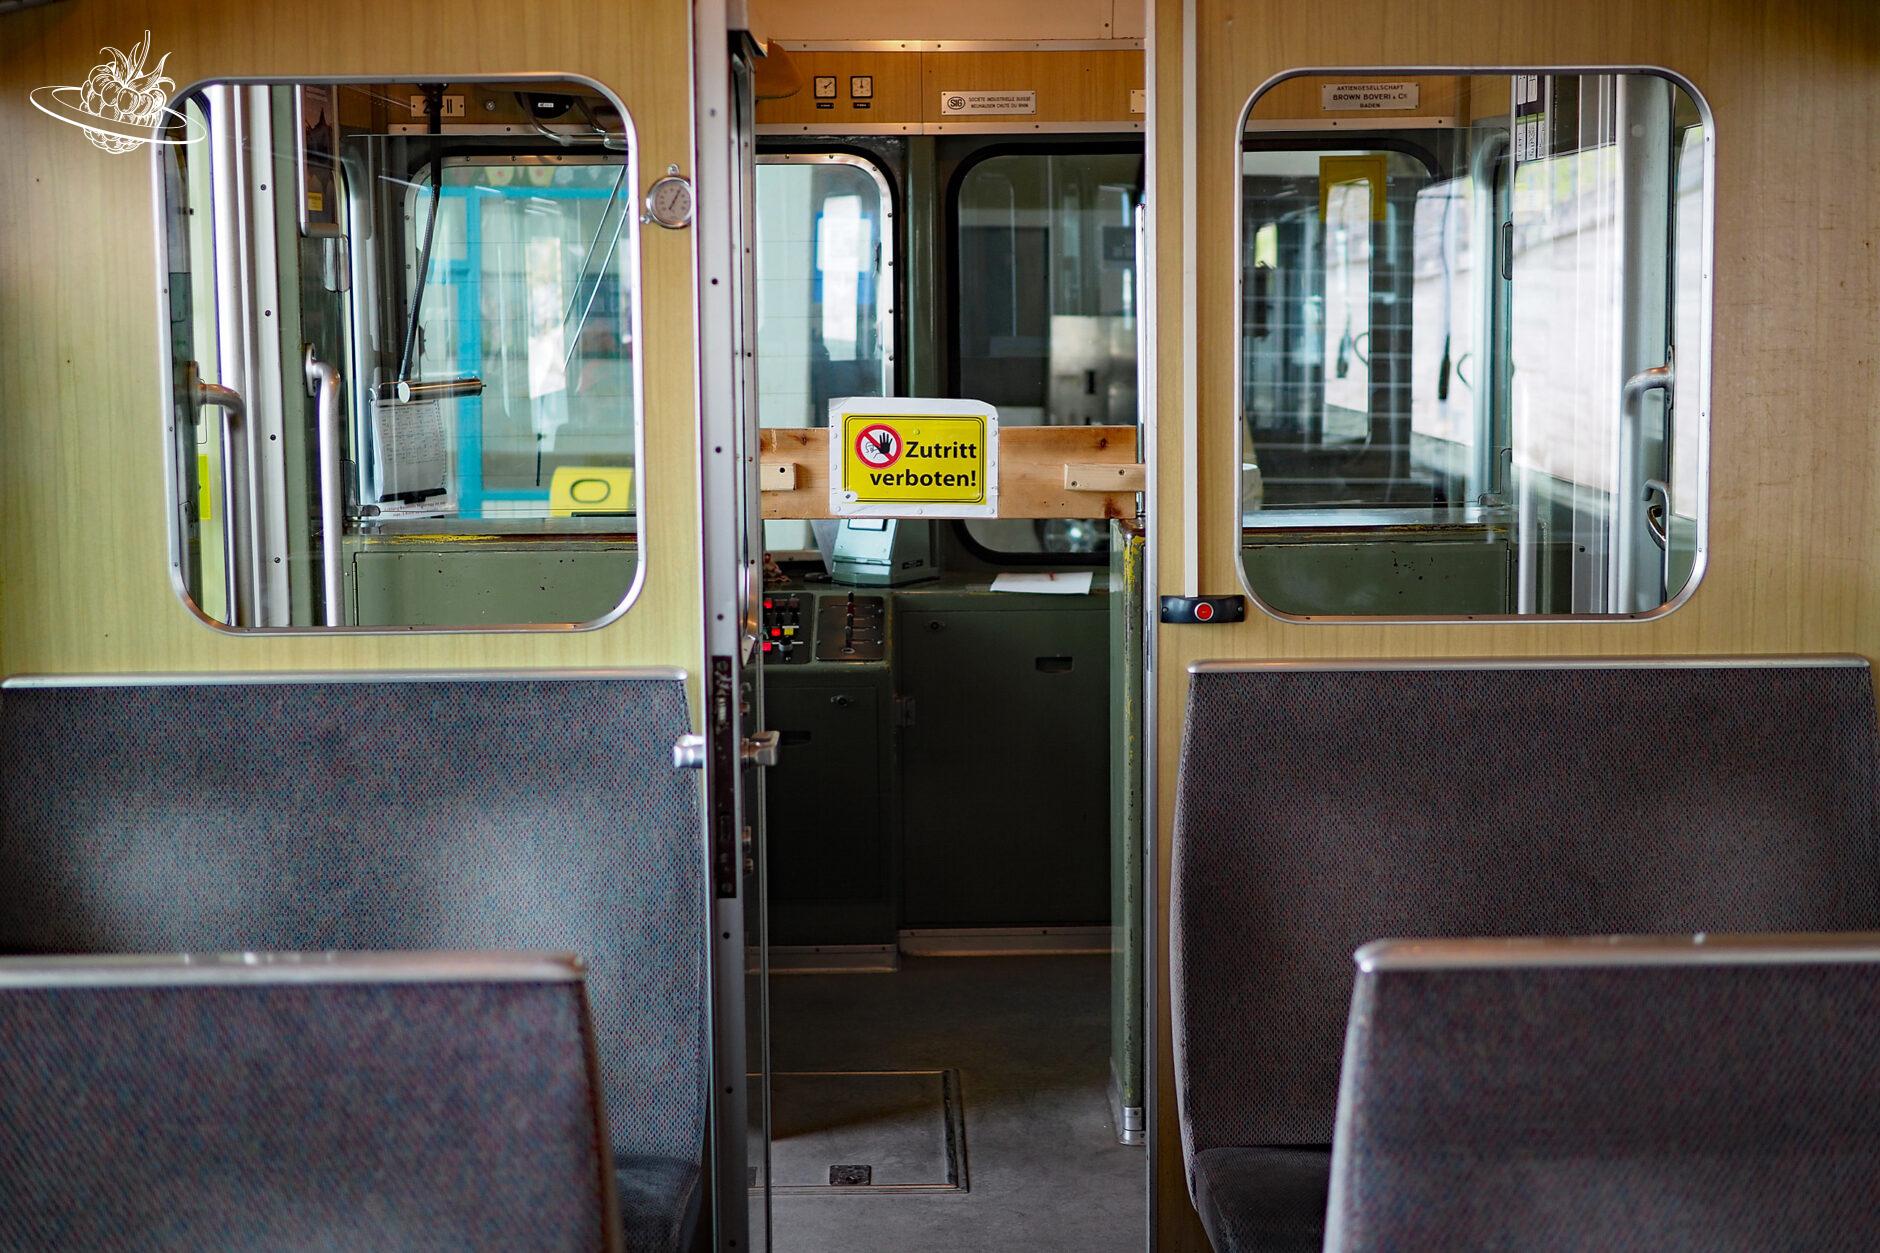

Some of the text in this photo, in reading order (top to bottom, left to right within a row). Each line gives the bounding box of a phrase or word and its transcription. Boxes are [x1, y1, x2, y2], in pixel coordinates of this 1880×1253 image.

[950, 99, 963, 108] SIG
[905, 441, 977, 459] Zutritt
[869, 468, 977, 487] verboten!
